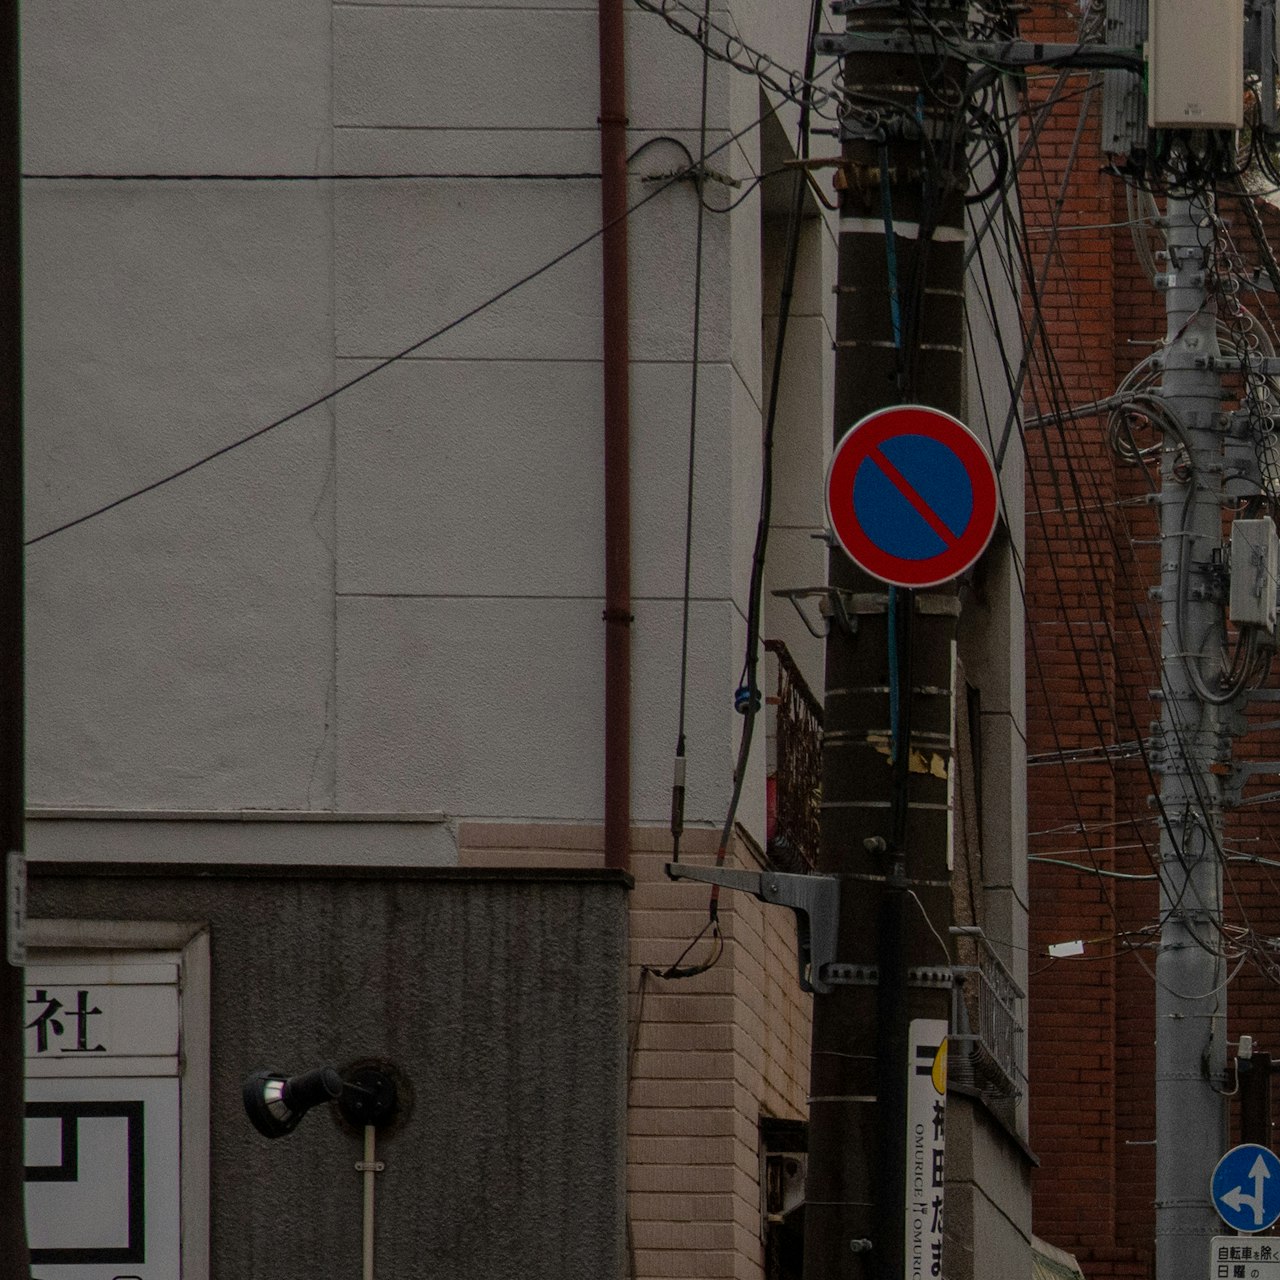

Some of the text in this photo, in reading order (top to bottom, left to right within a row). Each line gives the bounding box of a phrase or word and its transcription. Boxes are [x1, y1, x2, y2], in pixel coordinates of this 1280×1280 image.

[26, 990, 107, 1053] 社
[914, 1123, 924, 1198] OMURICE
[1218, 1246, 1280, 1261] 自転車を除く
[1218, 1265, 1260, 1279] 日曜の
